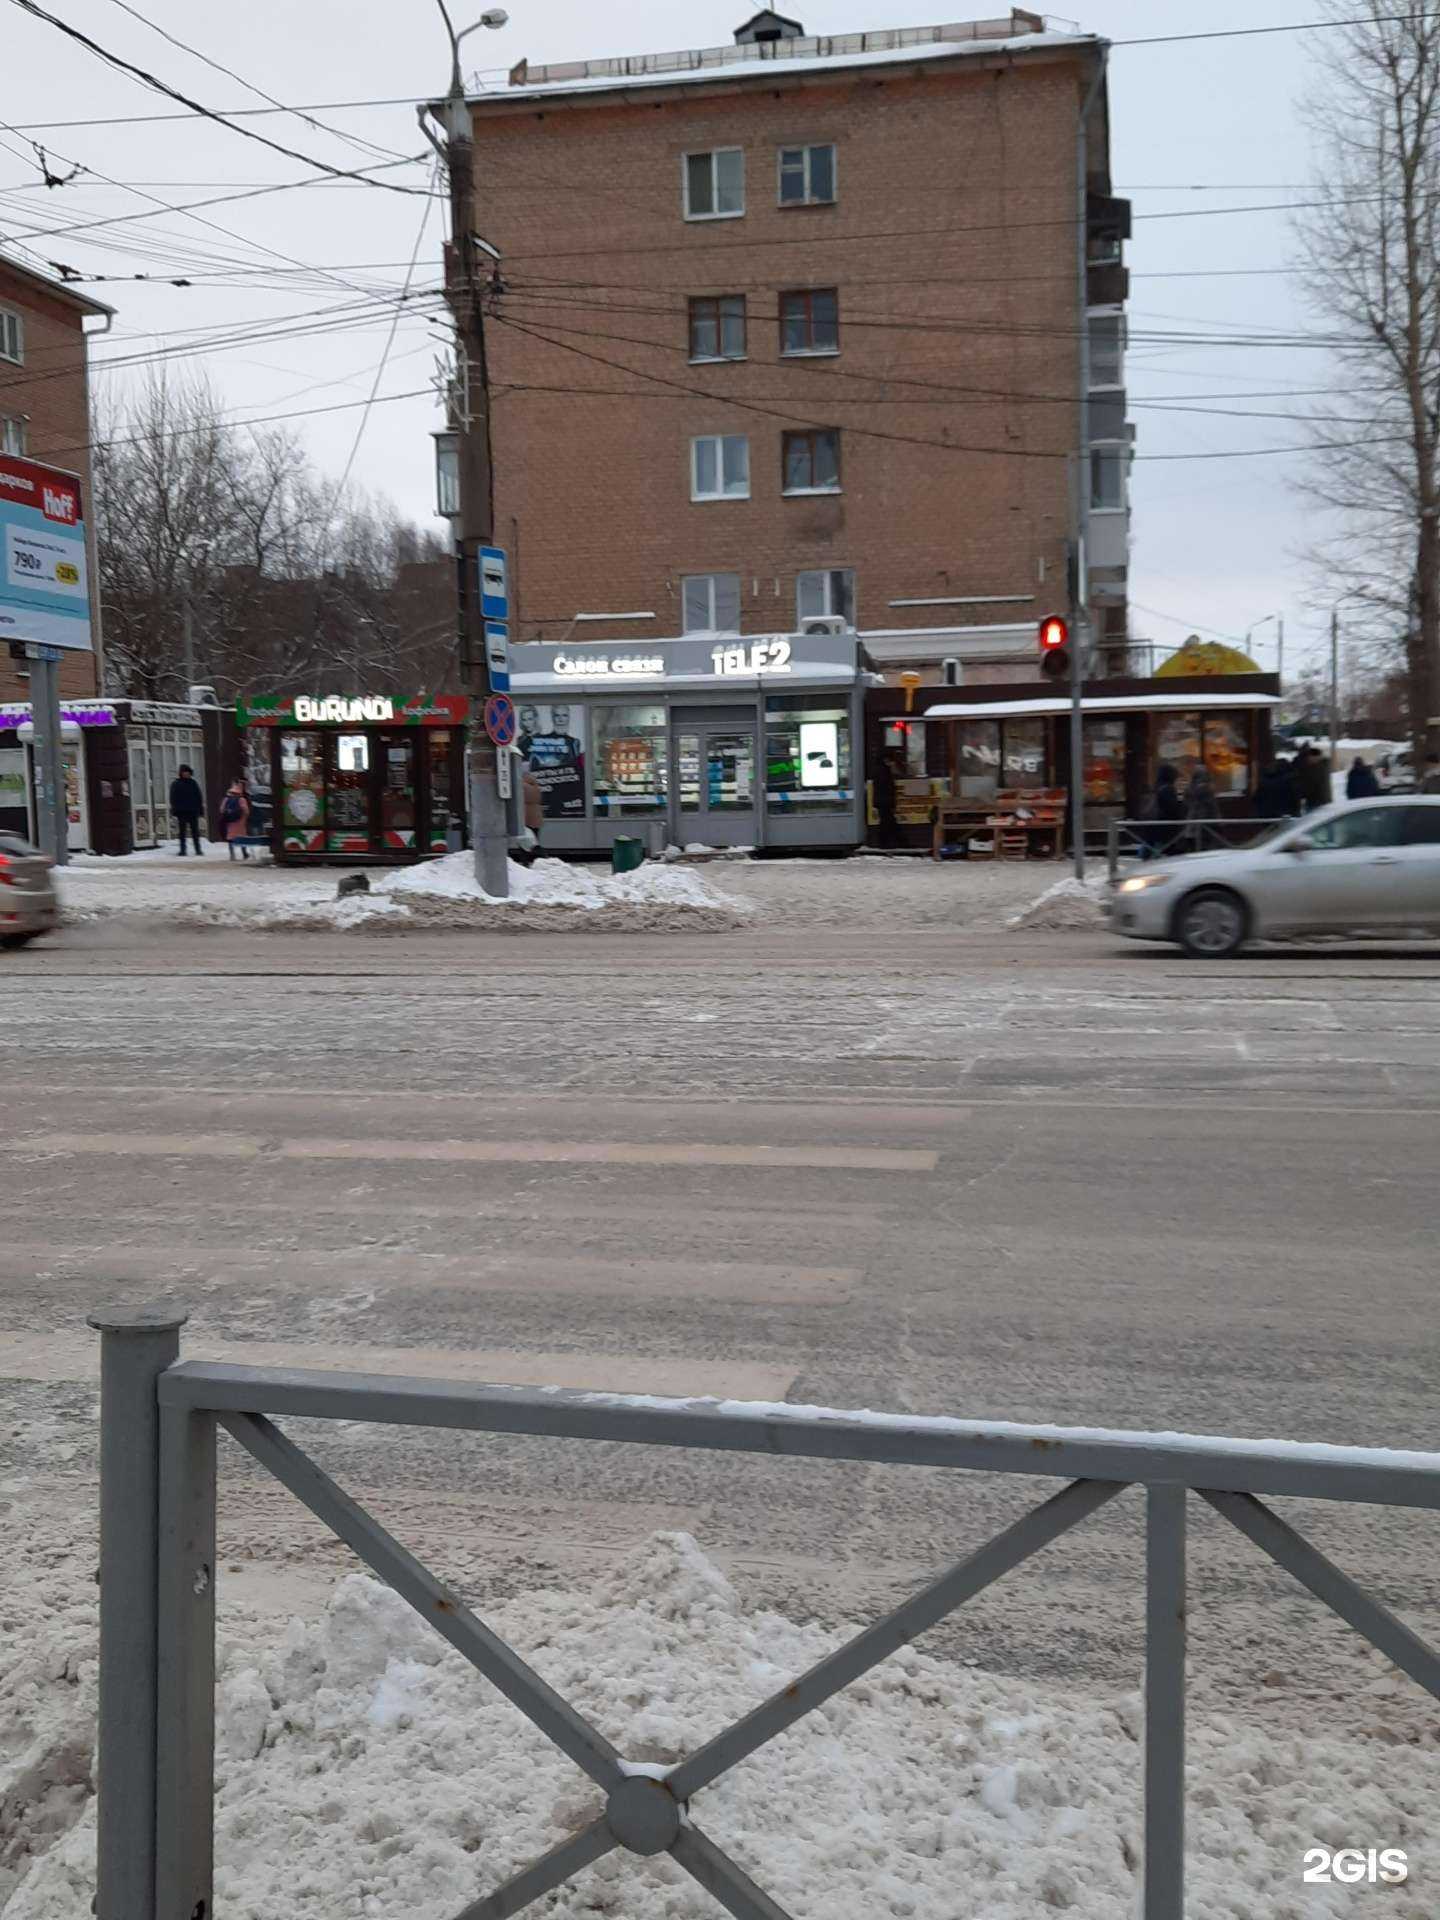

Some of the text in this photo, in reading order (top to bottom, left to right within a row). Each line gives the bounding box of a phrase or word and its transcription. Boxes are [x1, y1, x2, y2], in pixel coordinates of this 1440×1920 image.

[43, 487, 74, 520] Hoff
[553, 655, 664, 674] Салон связи
[711, 640, 792, 675] TELE2
[294, 696, 394, 722] BURUNDI
